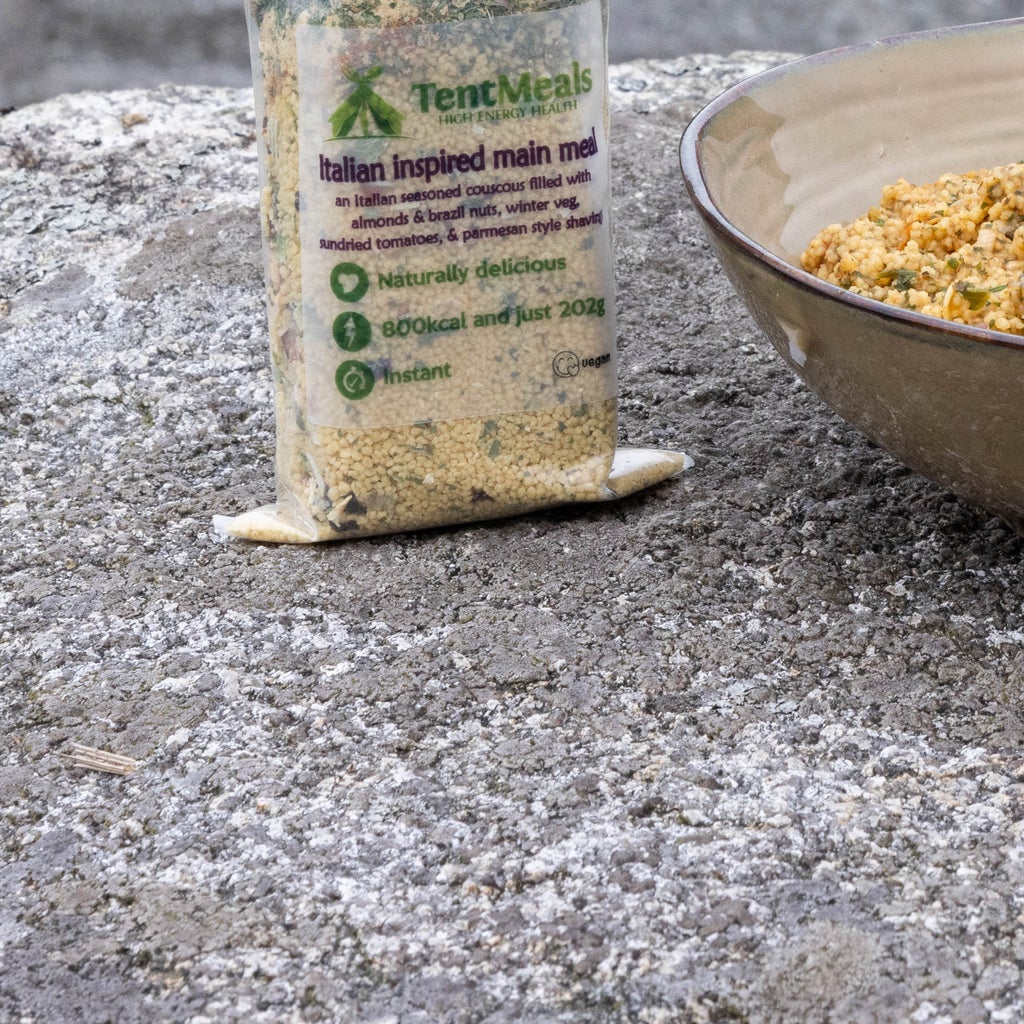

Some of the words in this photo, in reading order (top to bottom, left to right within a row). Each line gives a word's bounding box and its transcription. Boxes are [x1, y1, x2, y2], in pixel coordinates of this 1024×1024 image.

[412, 61, 592, 112] TentMeals
[439, 113, 472, 125] HIGH
[479, 107, 527, 122] ENERGY
[531, 101, 577, 116] HEALTH
[319, 154, 385, 183] Italian
[393, 145, 484, 183] inspired
[494, 141, 550, 169] main
[560, 127, 598, 161] meal
[335, 196, 349, 207] an
[355, 188, 396, 206] Italian
[401, 184, 461, 203] seasoned
[466, 179, 524, 196] couscous
[529, 172, 562, 190] filled
[567, 170, 591, 186] with
[351, 212, 409, 229] almonds
[414, 211, 425, 222] &
[428, 204, 464, 221] brazil
[470, 204, 501, 218] nuts,
[506, 199, 547, 214] winter
[320, 231, 371, 251] sundried
[376, 233, 443, 249] tomatoes,
[448, 229, 459, 241] &
[463, 223, 527, 242] parmesan
[531, 218, 561, 234] style
[379, 264, 469, 290] Naturally
[479, 256, 566, 278] delicious
[382, 316, 466, 337] 800kcal
[473, 308, 509, 326] and
[515, 303, 551, 327] just
[560, 297, 605, 317] 202g
[582, 353, 610, 369] vegan
